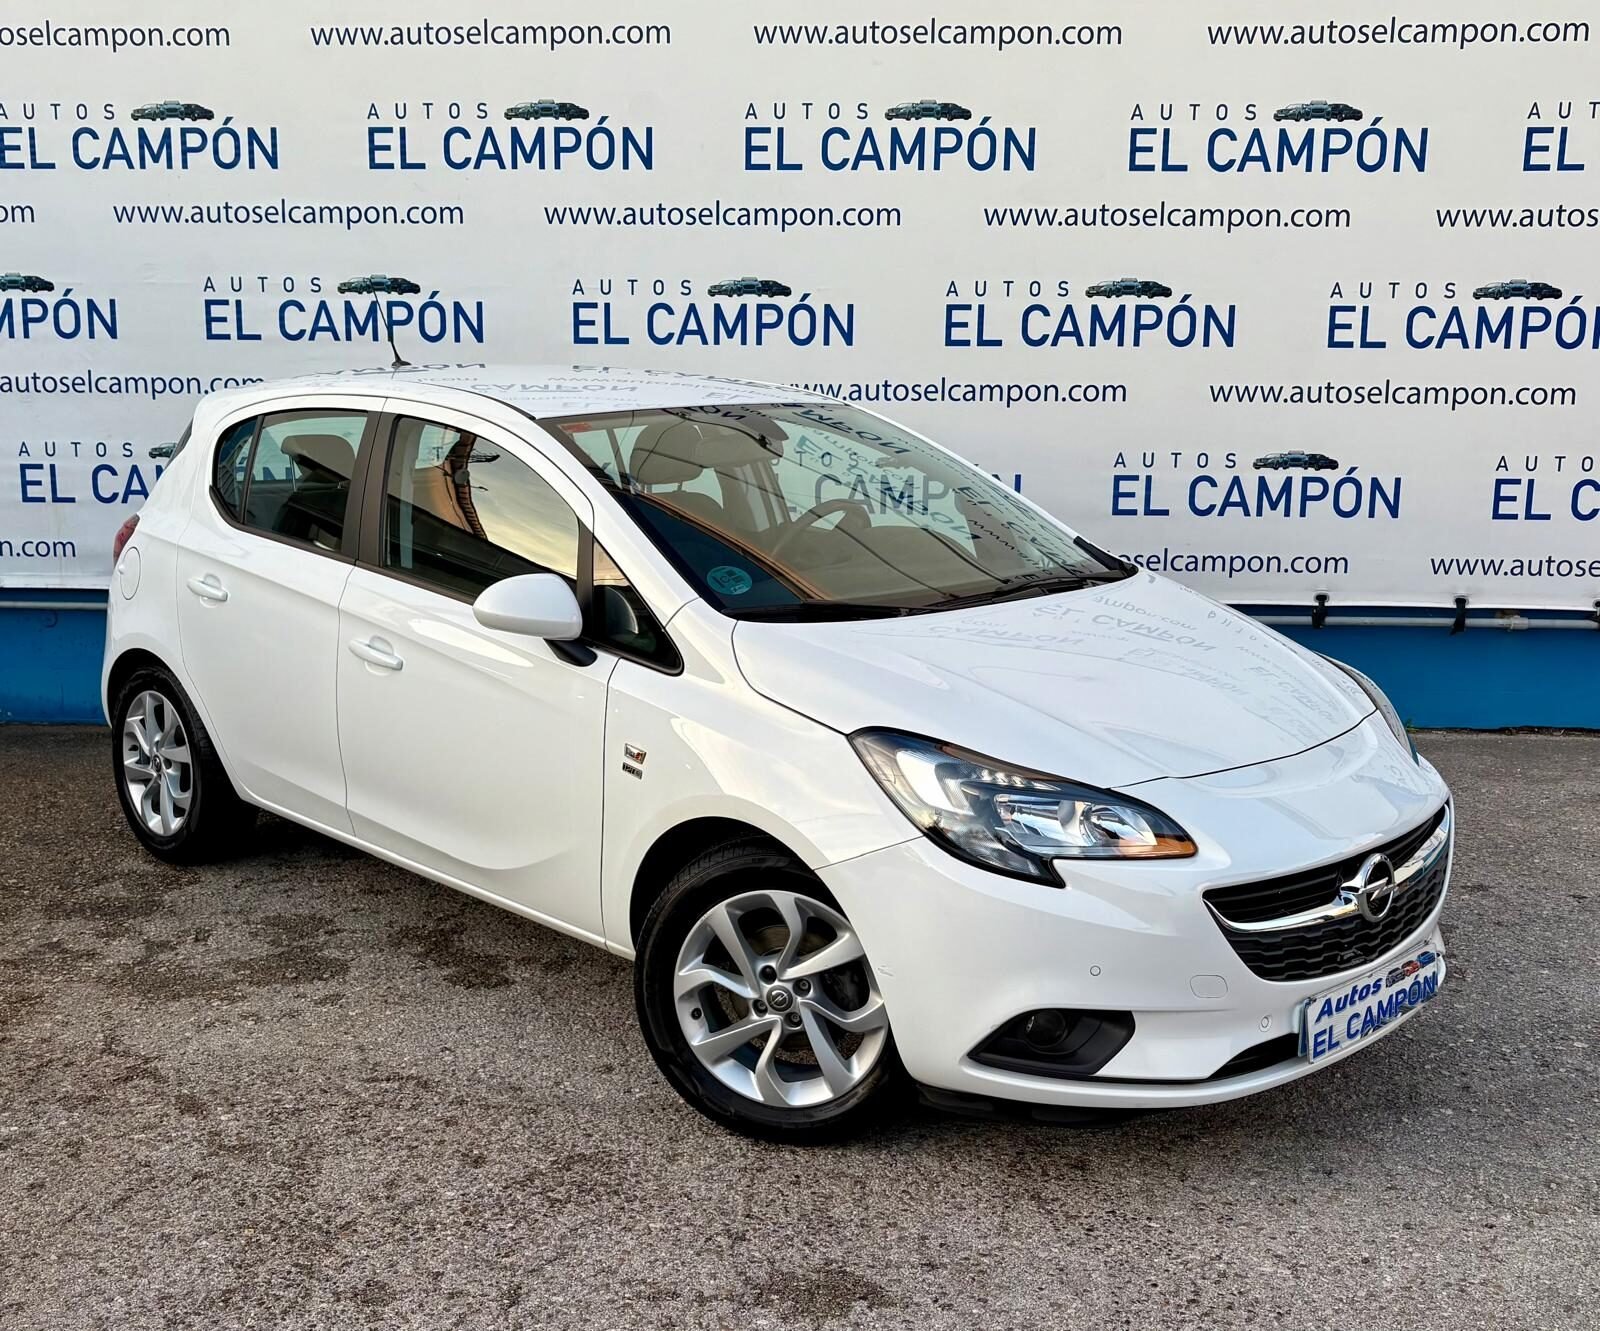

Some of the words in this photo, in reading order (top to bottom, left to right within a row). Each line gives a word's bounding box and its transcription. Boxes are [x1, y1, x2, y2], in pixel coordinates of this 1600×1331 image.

[311, 18, 671, 51] www.autoselcampon.com
[754, 18, 1122, 51] www.autoselcampon.com
[1208, 16, 1590, 49] www.autoselcampon.com
[0, 102, 115, 120] AUTOS
[367, 102, 488, 120] AUTOS
[745, 102, 869, 120] AUTOS
[1131, 103, 1257, 121] AUTOS
[0, 127, 56, 169] EL
[72, 117, 278, 170] CAMPÓN
[368, 127, 426, 170] EL
[444, 116, 652, 170] CAMPÓN
[745, 127, 803, 170] EL
[822, 116, 1035, 171] CAMPÓN
[1129, 128, 1188, 172] EL
[1208, 117, 1428, 173] CAMPÓN
[1523, 127, 1584, 171] EL
[113, 199, 464, 230] www.autoselcampon.com
[544, 200, 901, 231] www.autoselcampon.com
[984, 201, 1351, 233] www.autoselcampon.com
[1436, 205, 1599, 227] www.autos
[204, 276, 322, 293] AUTOS
[572, 279, 692, 296] AUTOS
[946, 281, 1069, 298] AUTOS
[1330, 282, 1456, 299] AUTOS
[205, 299, 262, 341] EL
[279, 291, 484, 343] CAMPÓN
[573, 302, 630, 344] EL
[647, 293, 855, 346] CAMPÓN
[945, 304, 1002, 347] EL
[1022, 294, 1236, 347] CAMPÓN
[1328, 306, 1386, 349] EL
[1406, 296, 1600, 350] CAMPÓ
[1210, 379, 1576, 411] www.autoselcampon.com
[19, 442, 133, 458] AUTOS
[1114, 452, 1236, 469] AUTOS
[1496, 456, 1594, 472] AUTO
[20, 464, 76, 504] EL
[92, 464, 164, 504] CA
[1112, 475, 1169, 517] EL
[1189, 467, 1402, 518] CAMPÓN
[1492, 479, 1551, 520] EL
[1312, 1024, 1340, 1059] EL
[1346, 971, 1438, 1040] CAMPÓN
[1314, 977, 1384, 1024] Autos
